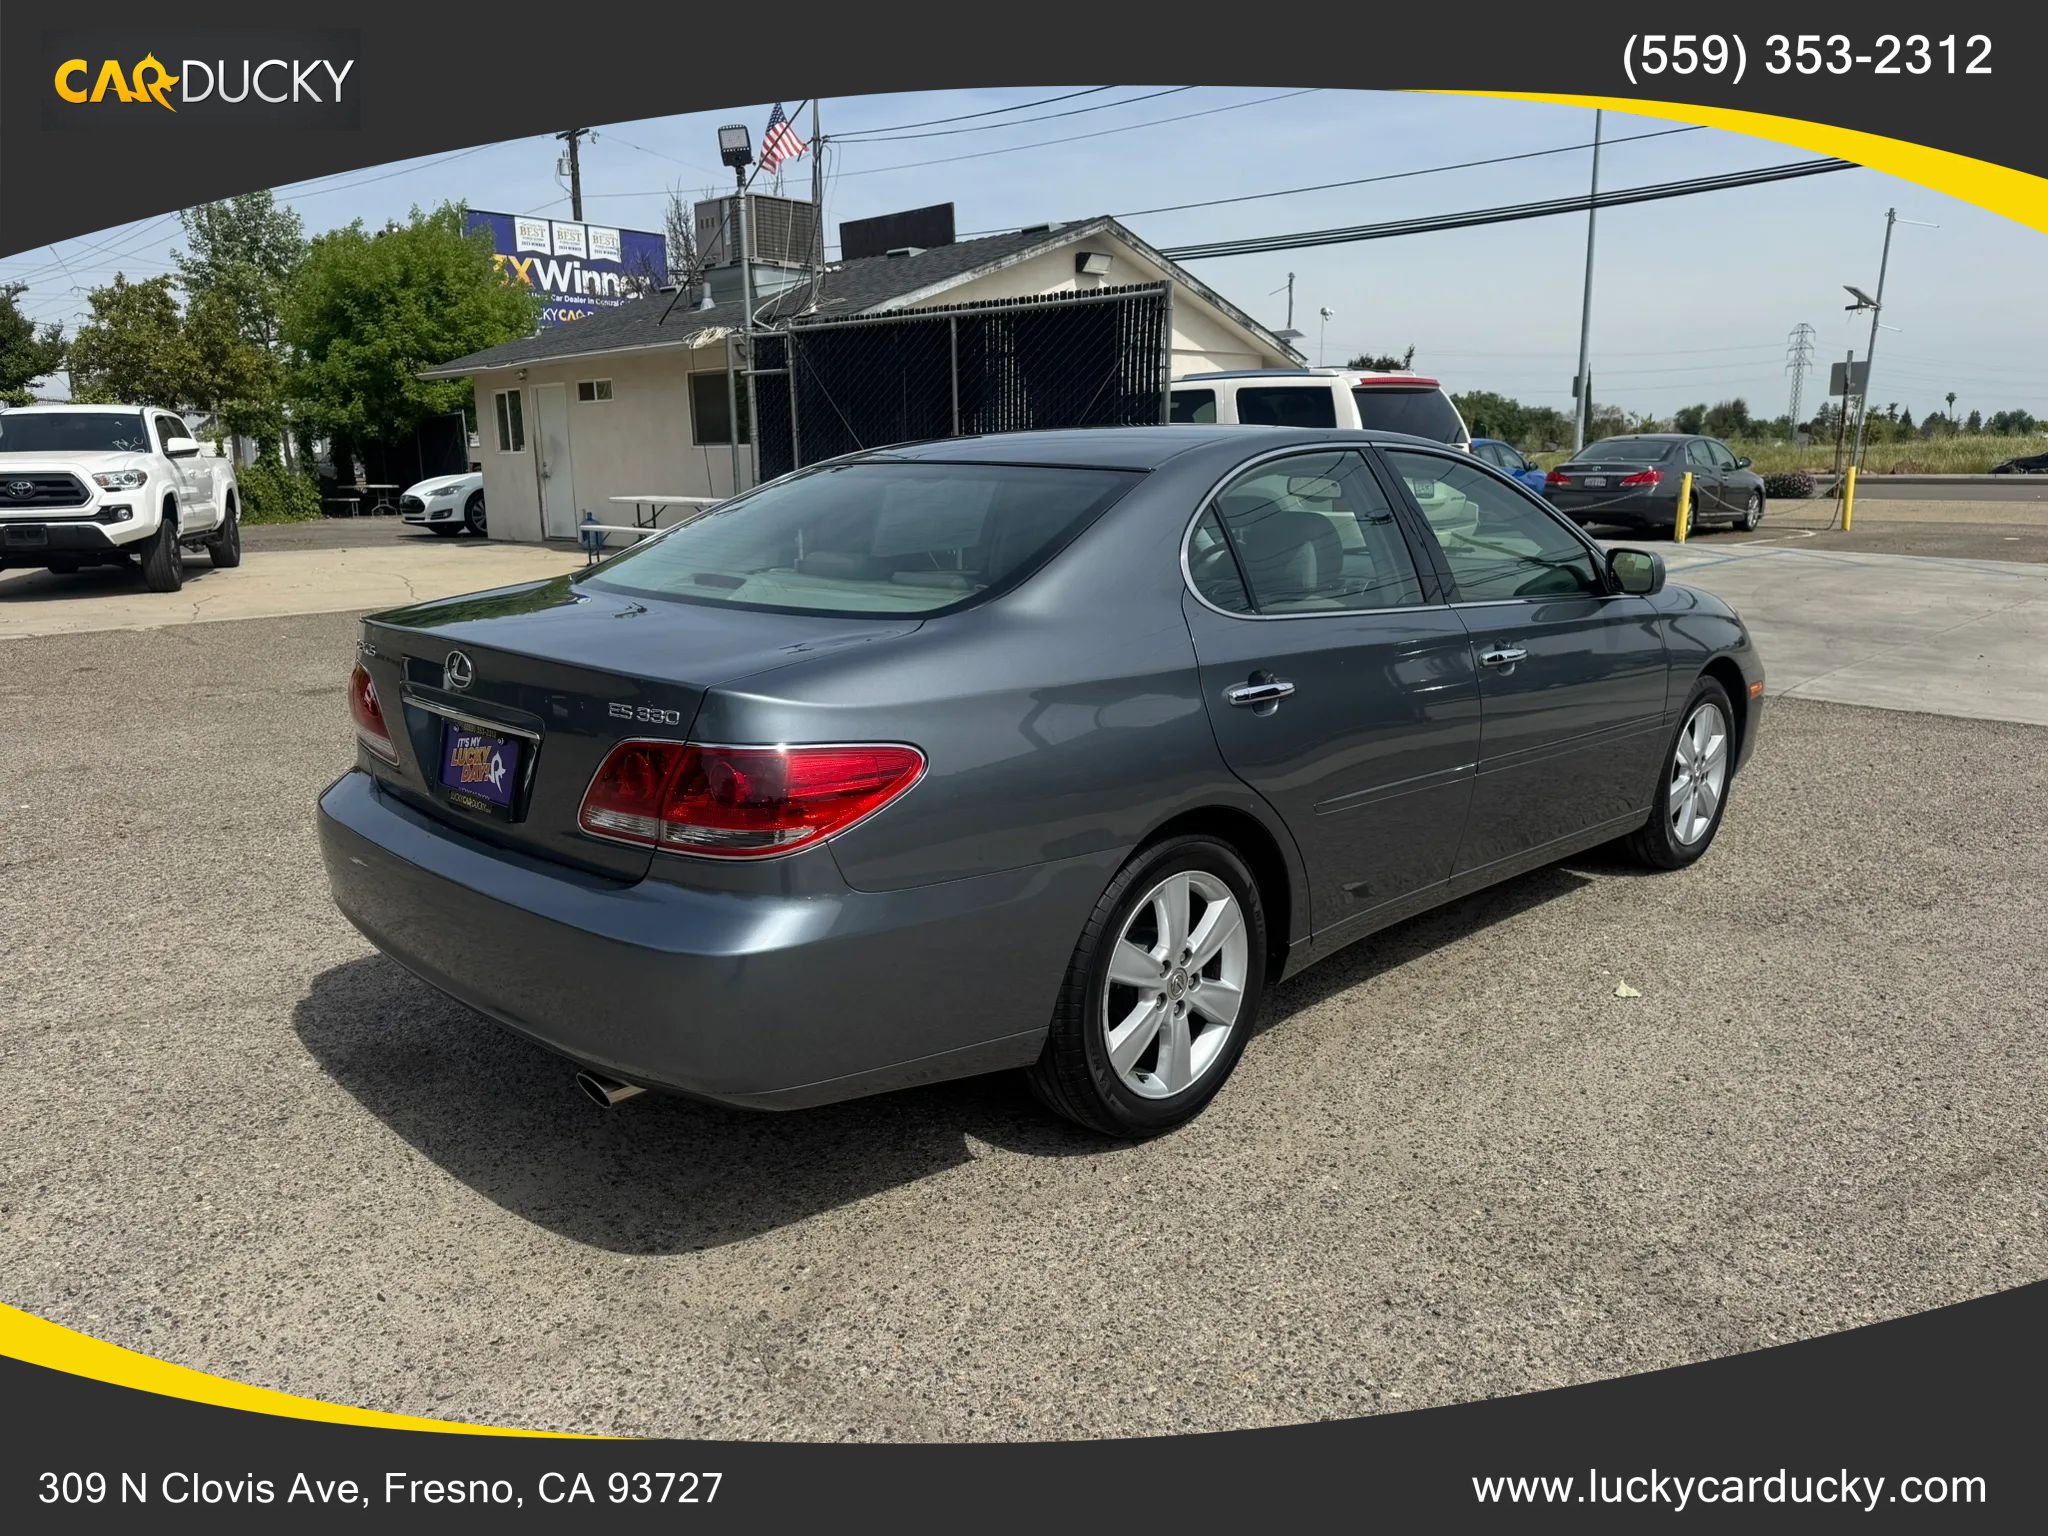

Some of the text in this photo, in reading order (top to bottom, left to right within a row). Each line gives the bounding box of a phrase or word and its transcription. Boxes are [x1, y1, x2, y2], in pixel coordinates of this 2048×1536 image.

[519, 225, 546, 238] BEST
[557, 230, 582, 242] BEST
[592, 234, 618, 247] BEST
[551, 294, 563, 302] Car
[564, 295, 587, 304] Dealer
[608, 702, 680, 725] ES 330
[457, 736, 482, 748] IT'S MY
[451, 746, 492, 767] LUCKY
